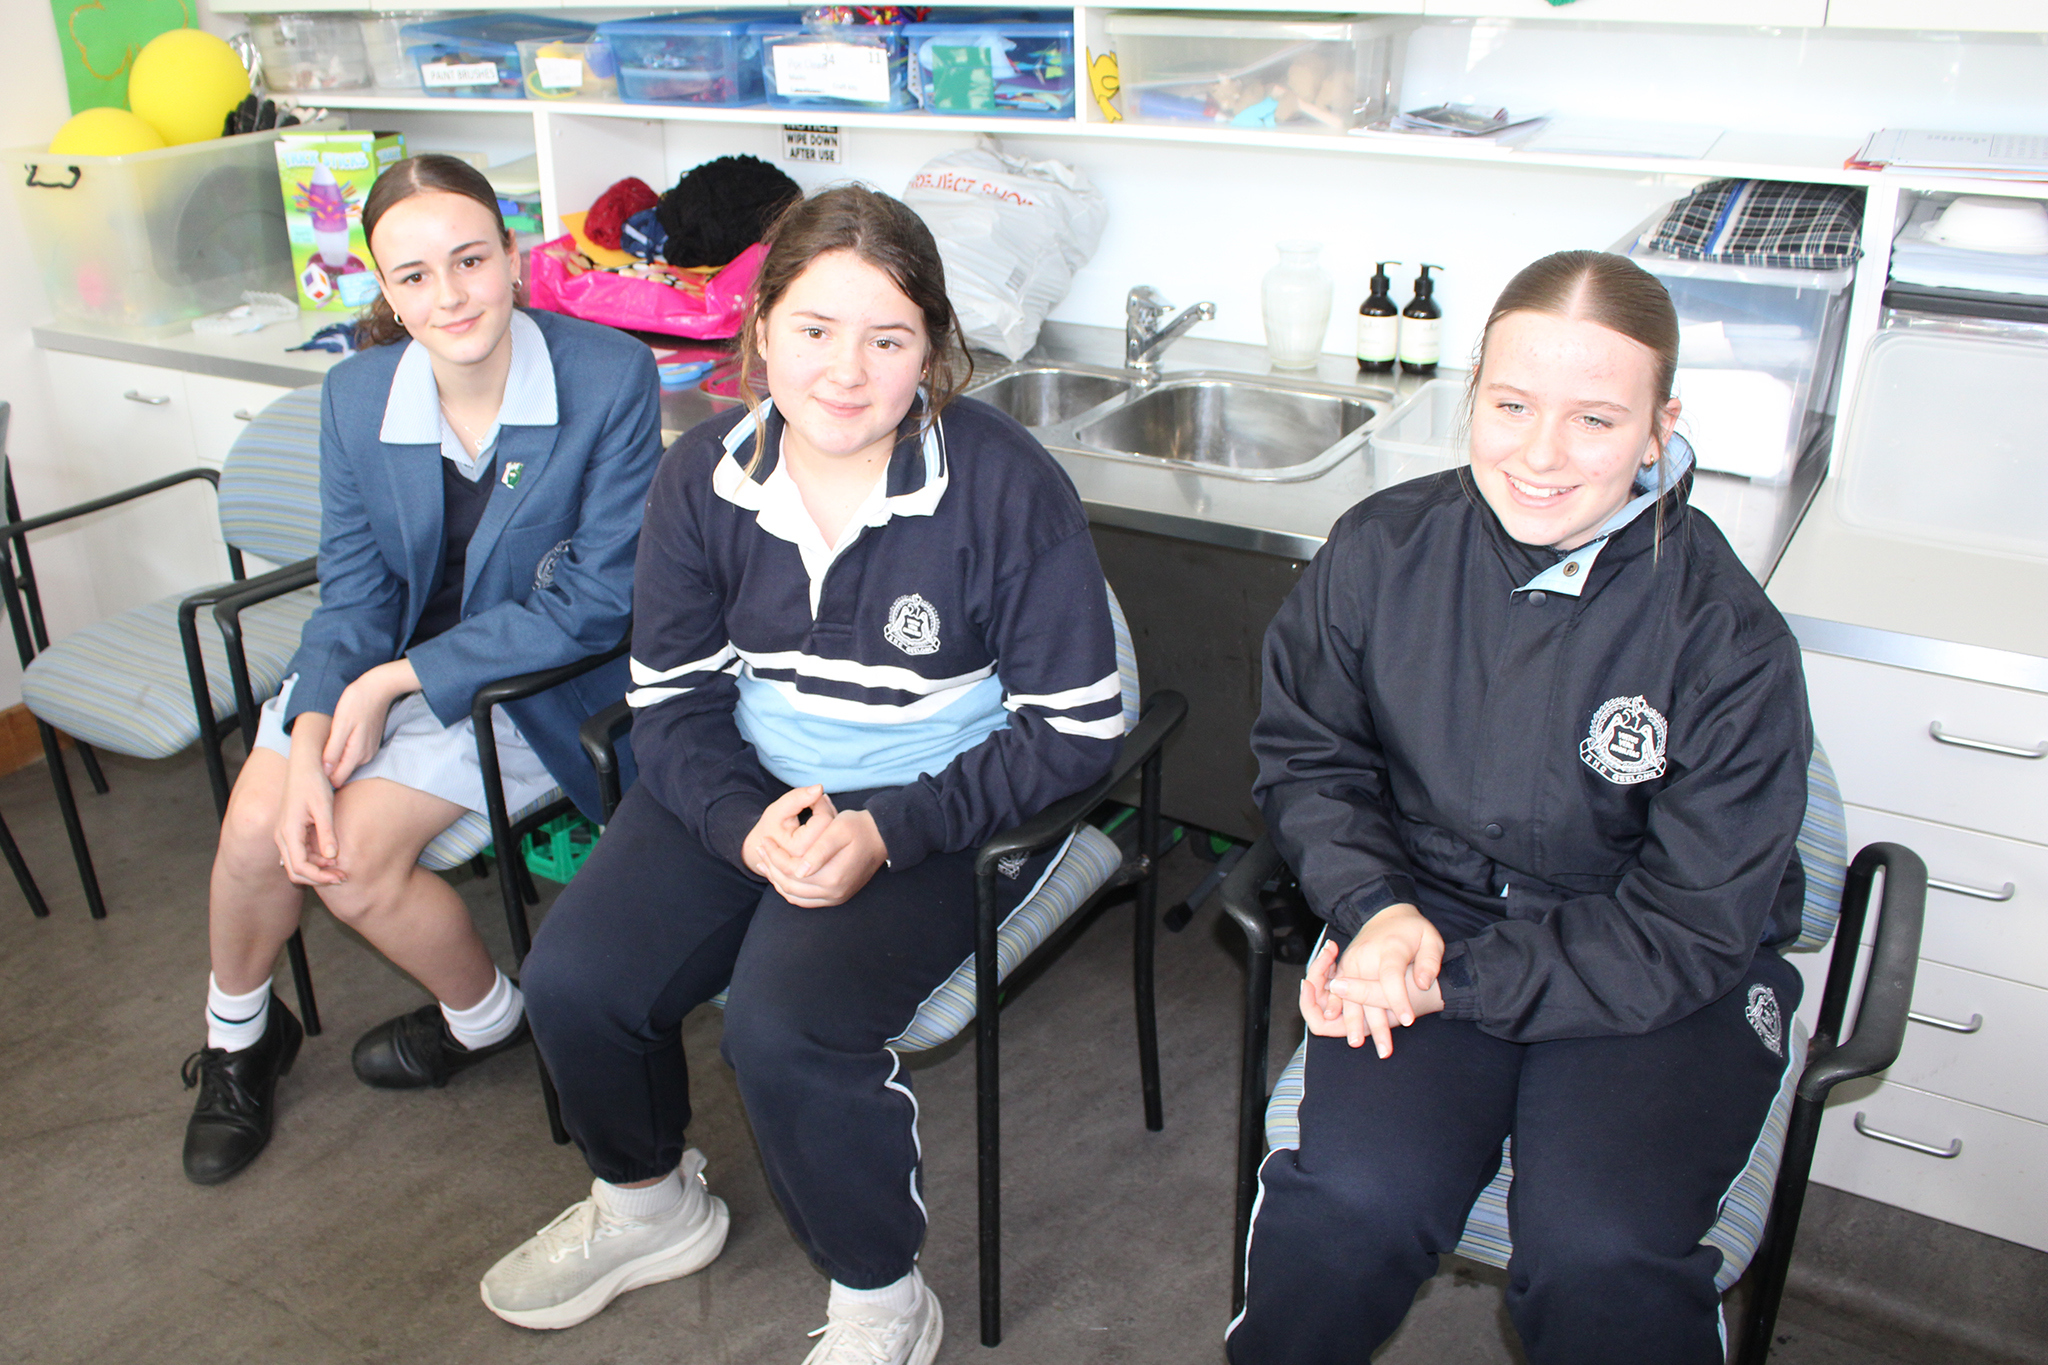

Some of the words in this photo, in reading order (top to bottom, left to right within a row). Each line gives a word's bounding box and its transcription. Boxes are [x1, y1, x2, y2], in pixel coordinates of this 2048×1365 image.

[822, 53, 836, 66] 34
[869, 51, 881, 64] 11
[430, 70, 455, 80] PAINT
[457, 68, 496, 80] BRUSHES
[786, 132, 807, 145] WIPE
[810, 133, 838, 146] DOWN
[790, 147, 816, 159] AFTER
[818, 149, 835, 161] USE
[1611, 771, 1657, 782] GEELONG
